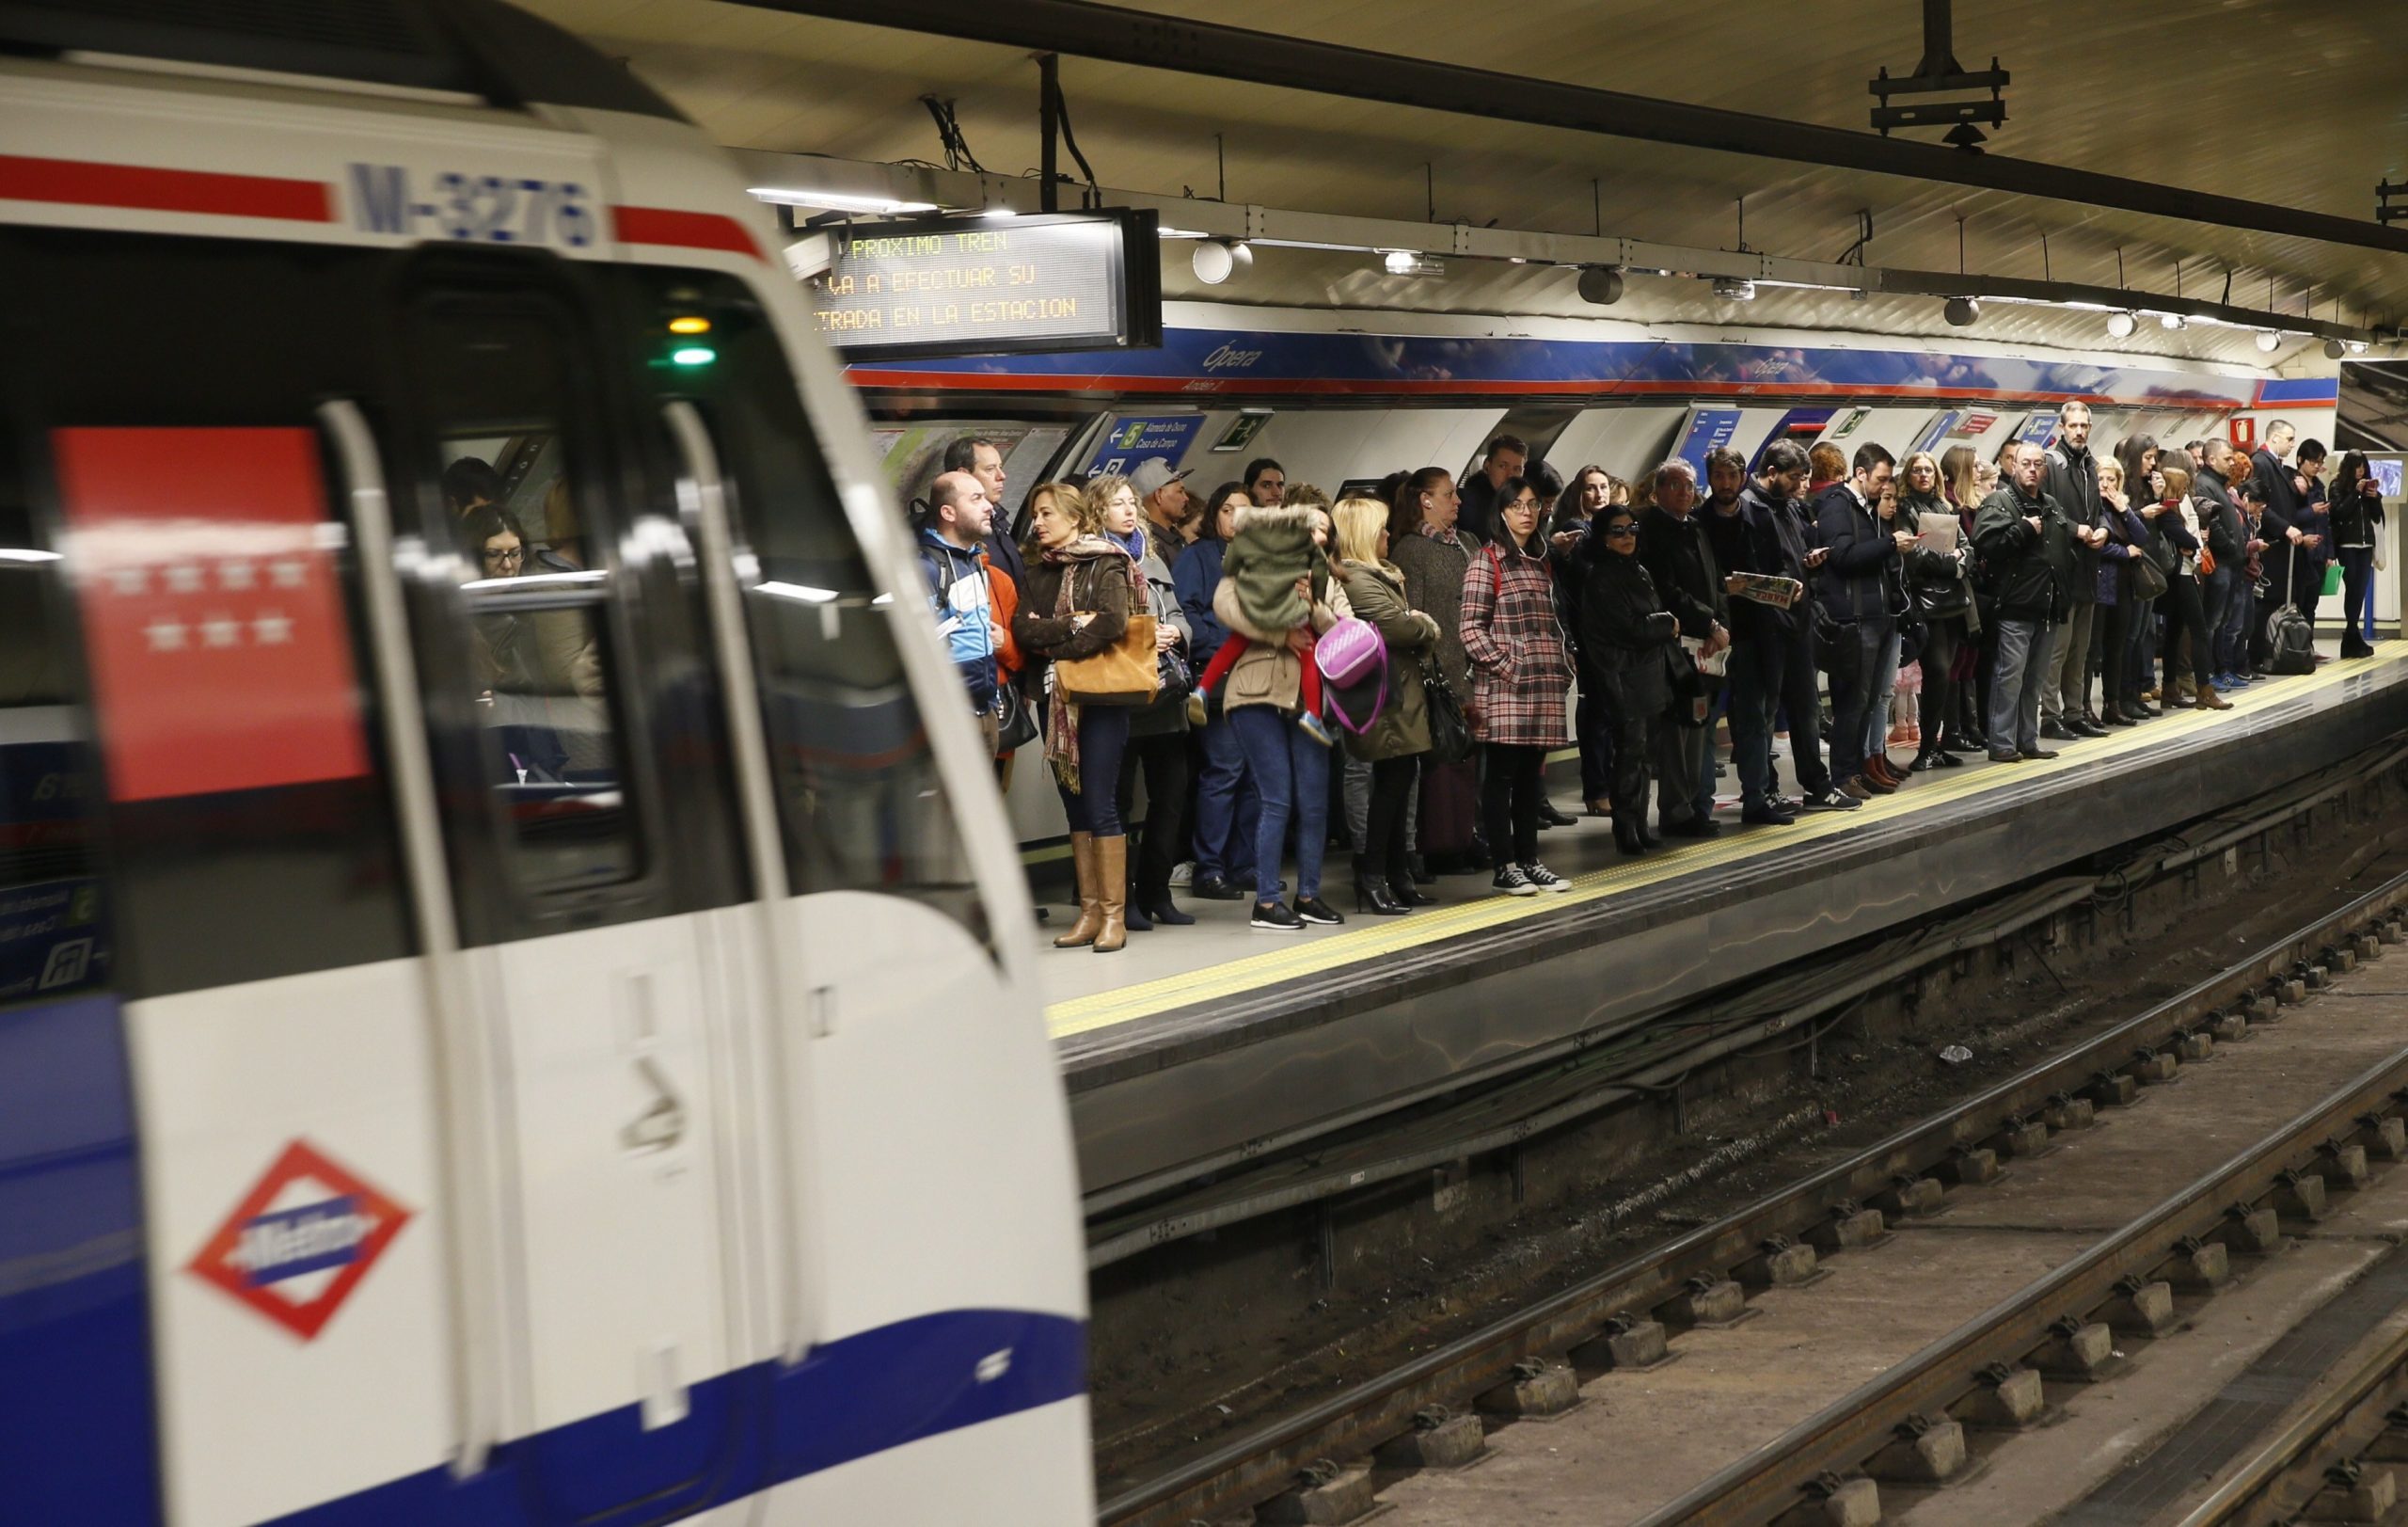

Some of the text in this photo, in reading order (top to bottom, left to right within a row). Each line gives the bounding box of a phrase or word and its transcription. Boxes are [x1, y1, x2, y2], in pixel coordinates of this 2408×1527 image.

[852, 231, 1007, 259] PROXIMO TREN
[866, 274, 880, 294] A
[893, 266, 996, 292] EFECTUAR
[1009, 264, 1035, 285] SU
[895, 307, 921, 326] EN
[933, 304, 958, 324] LA
[971, 298, 1077, 322] ESTACION
[1203, 340, 1262, 373] Ópera
[1124, 425, 1142, 446] 5
